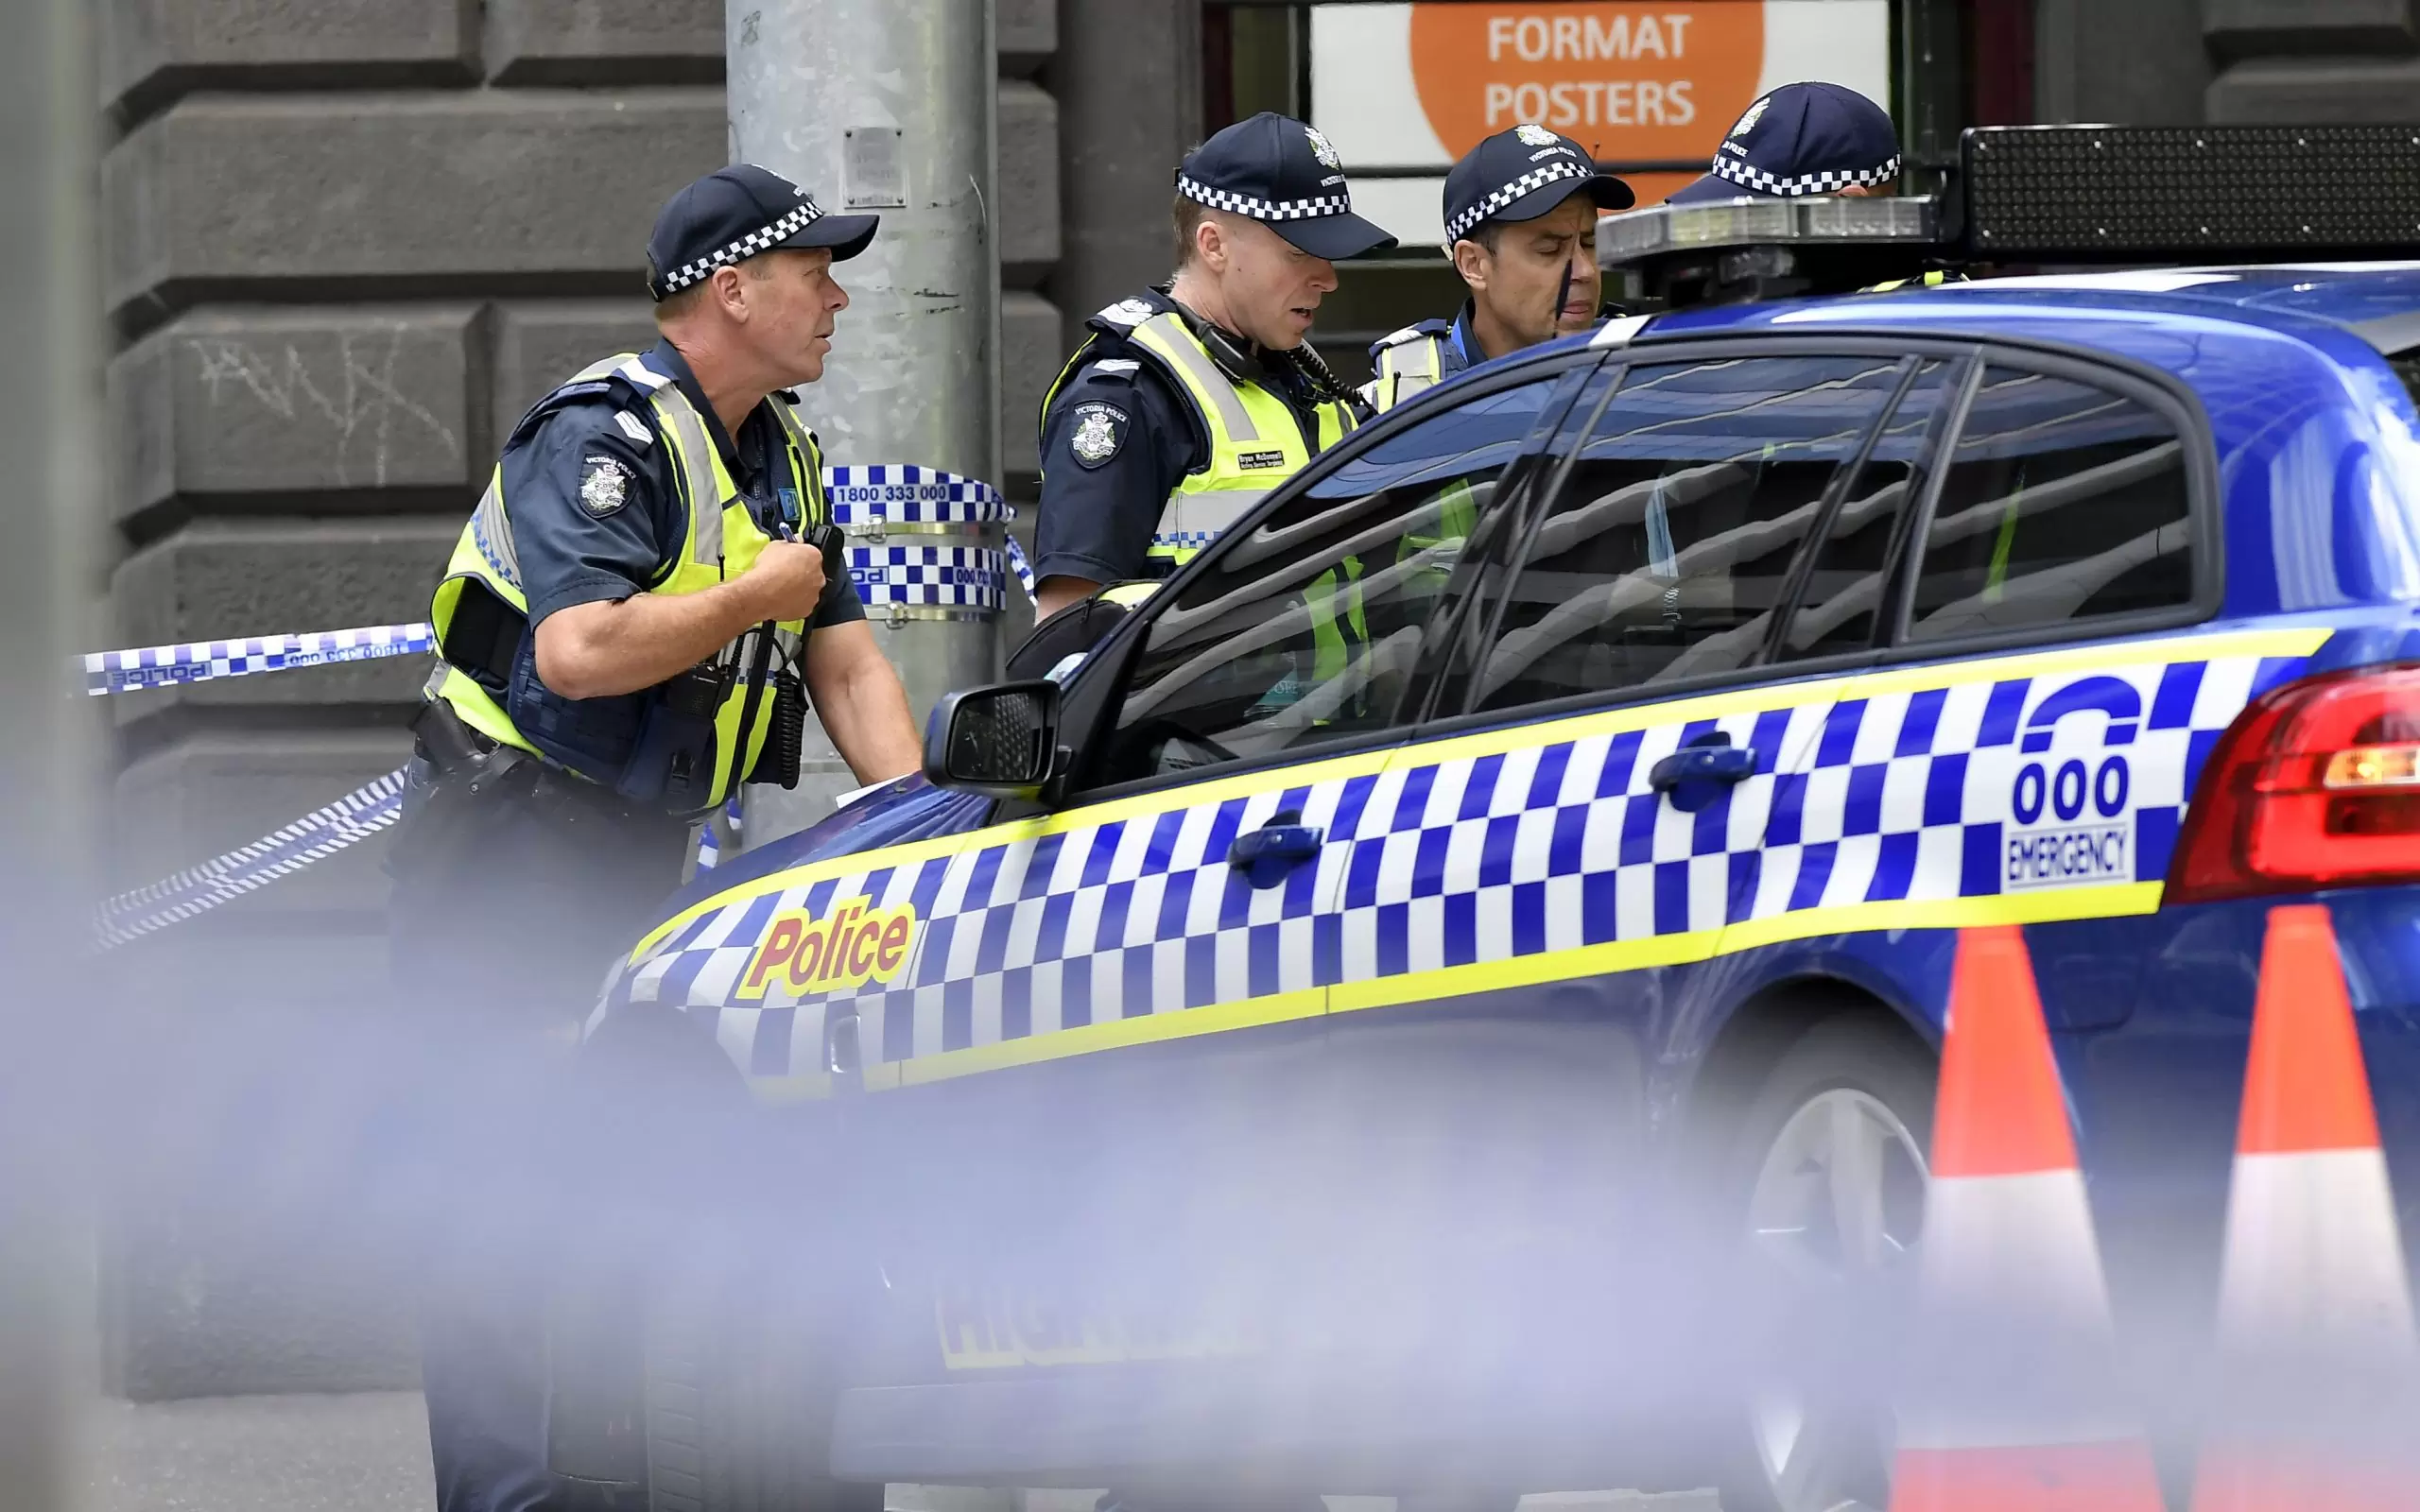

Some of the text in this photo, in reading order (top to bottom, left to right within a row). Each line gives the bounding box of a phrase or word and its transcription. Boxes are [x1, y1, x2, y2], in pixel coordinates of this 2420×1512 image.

[1488, 15, 1693, 61] FORMAT
[1484, 79, 1696, 128] POSTERS
[1075, 405, 1127, 422] VICTORIA POLICE
[586, 456, 617, 466] VICTORIA
[838, 486, 946, 502] 1800 333 000
[956, 570, 975, 584] 000
[289, 653, 320, 665] 000
[362, 644, 403, 659] 1800
[112, 664, 208, 684] POLICE
[2013, 755, 2130, 825] 000
[2009, 829, 2127, 881] EMERGENCY
[746, 905, 908, 987] Police
